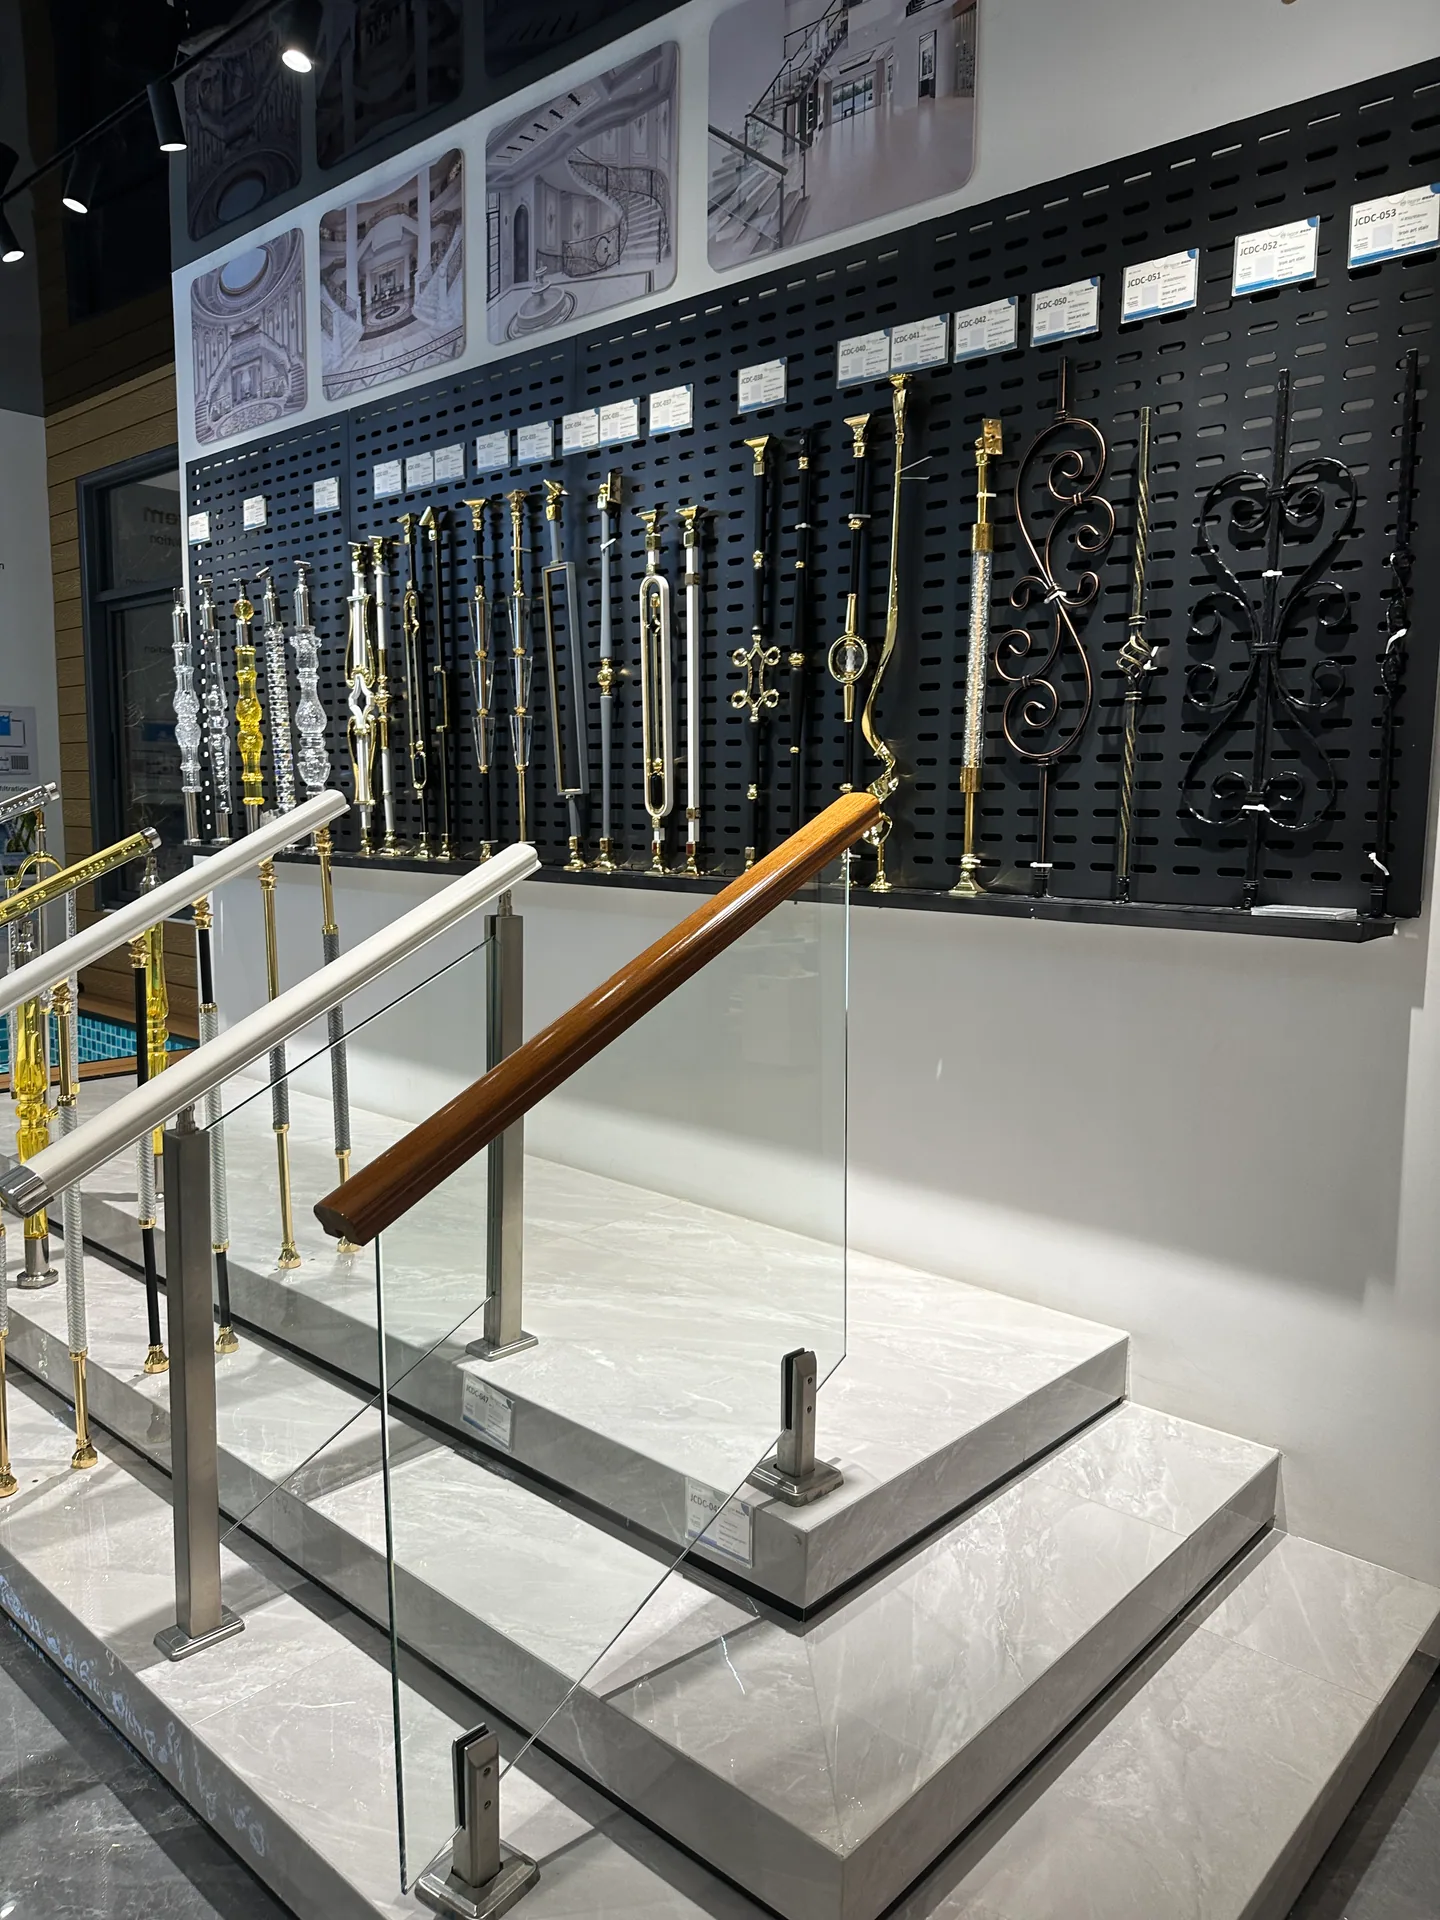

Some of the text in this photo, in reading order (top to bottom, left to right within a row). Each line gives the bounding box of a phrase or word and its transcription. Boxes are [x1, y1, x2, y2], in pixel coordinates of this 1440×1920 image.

[1354, 208, 1397, 227] JCDC-053
[1240, 240, 1278, 256] JCDC-052
[1127, 271, 1162, 288] JCDC-051
[1036, 296, 1068, 311] JCDC-050
[958, 315, 987, 330] JCDC-042
[893, 331, 920, 345] JCDC-041
